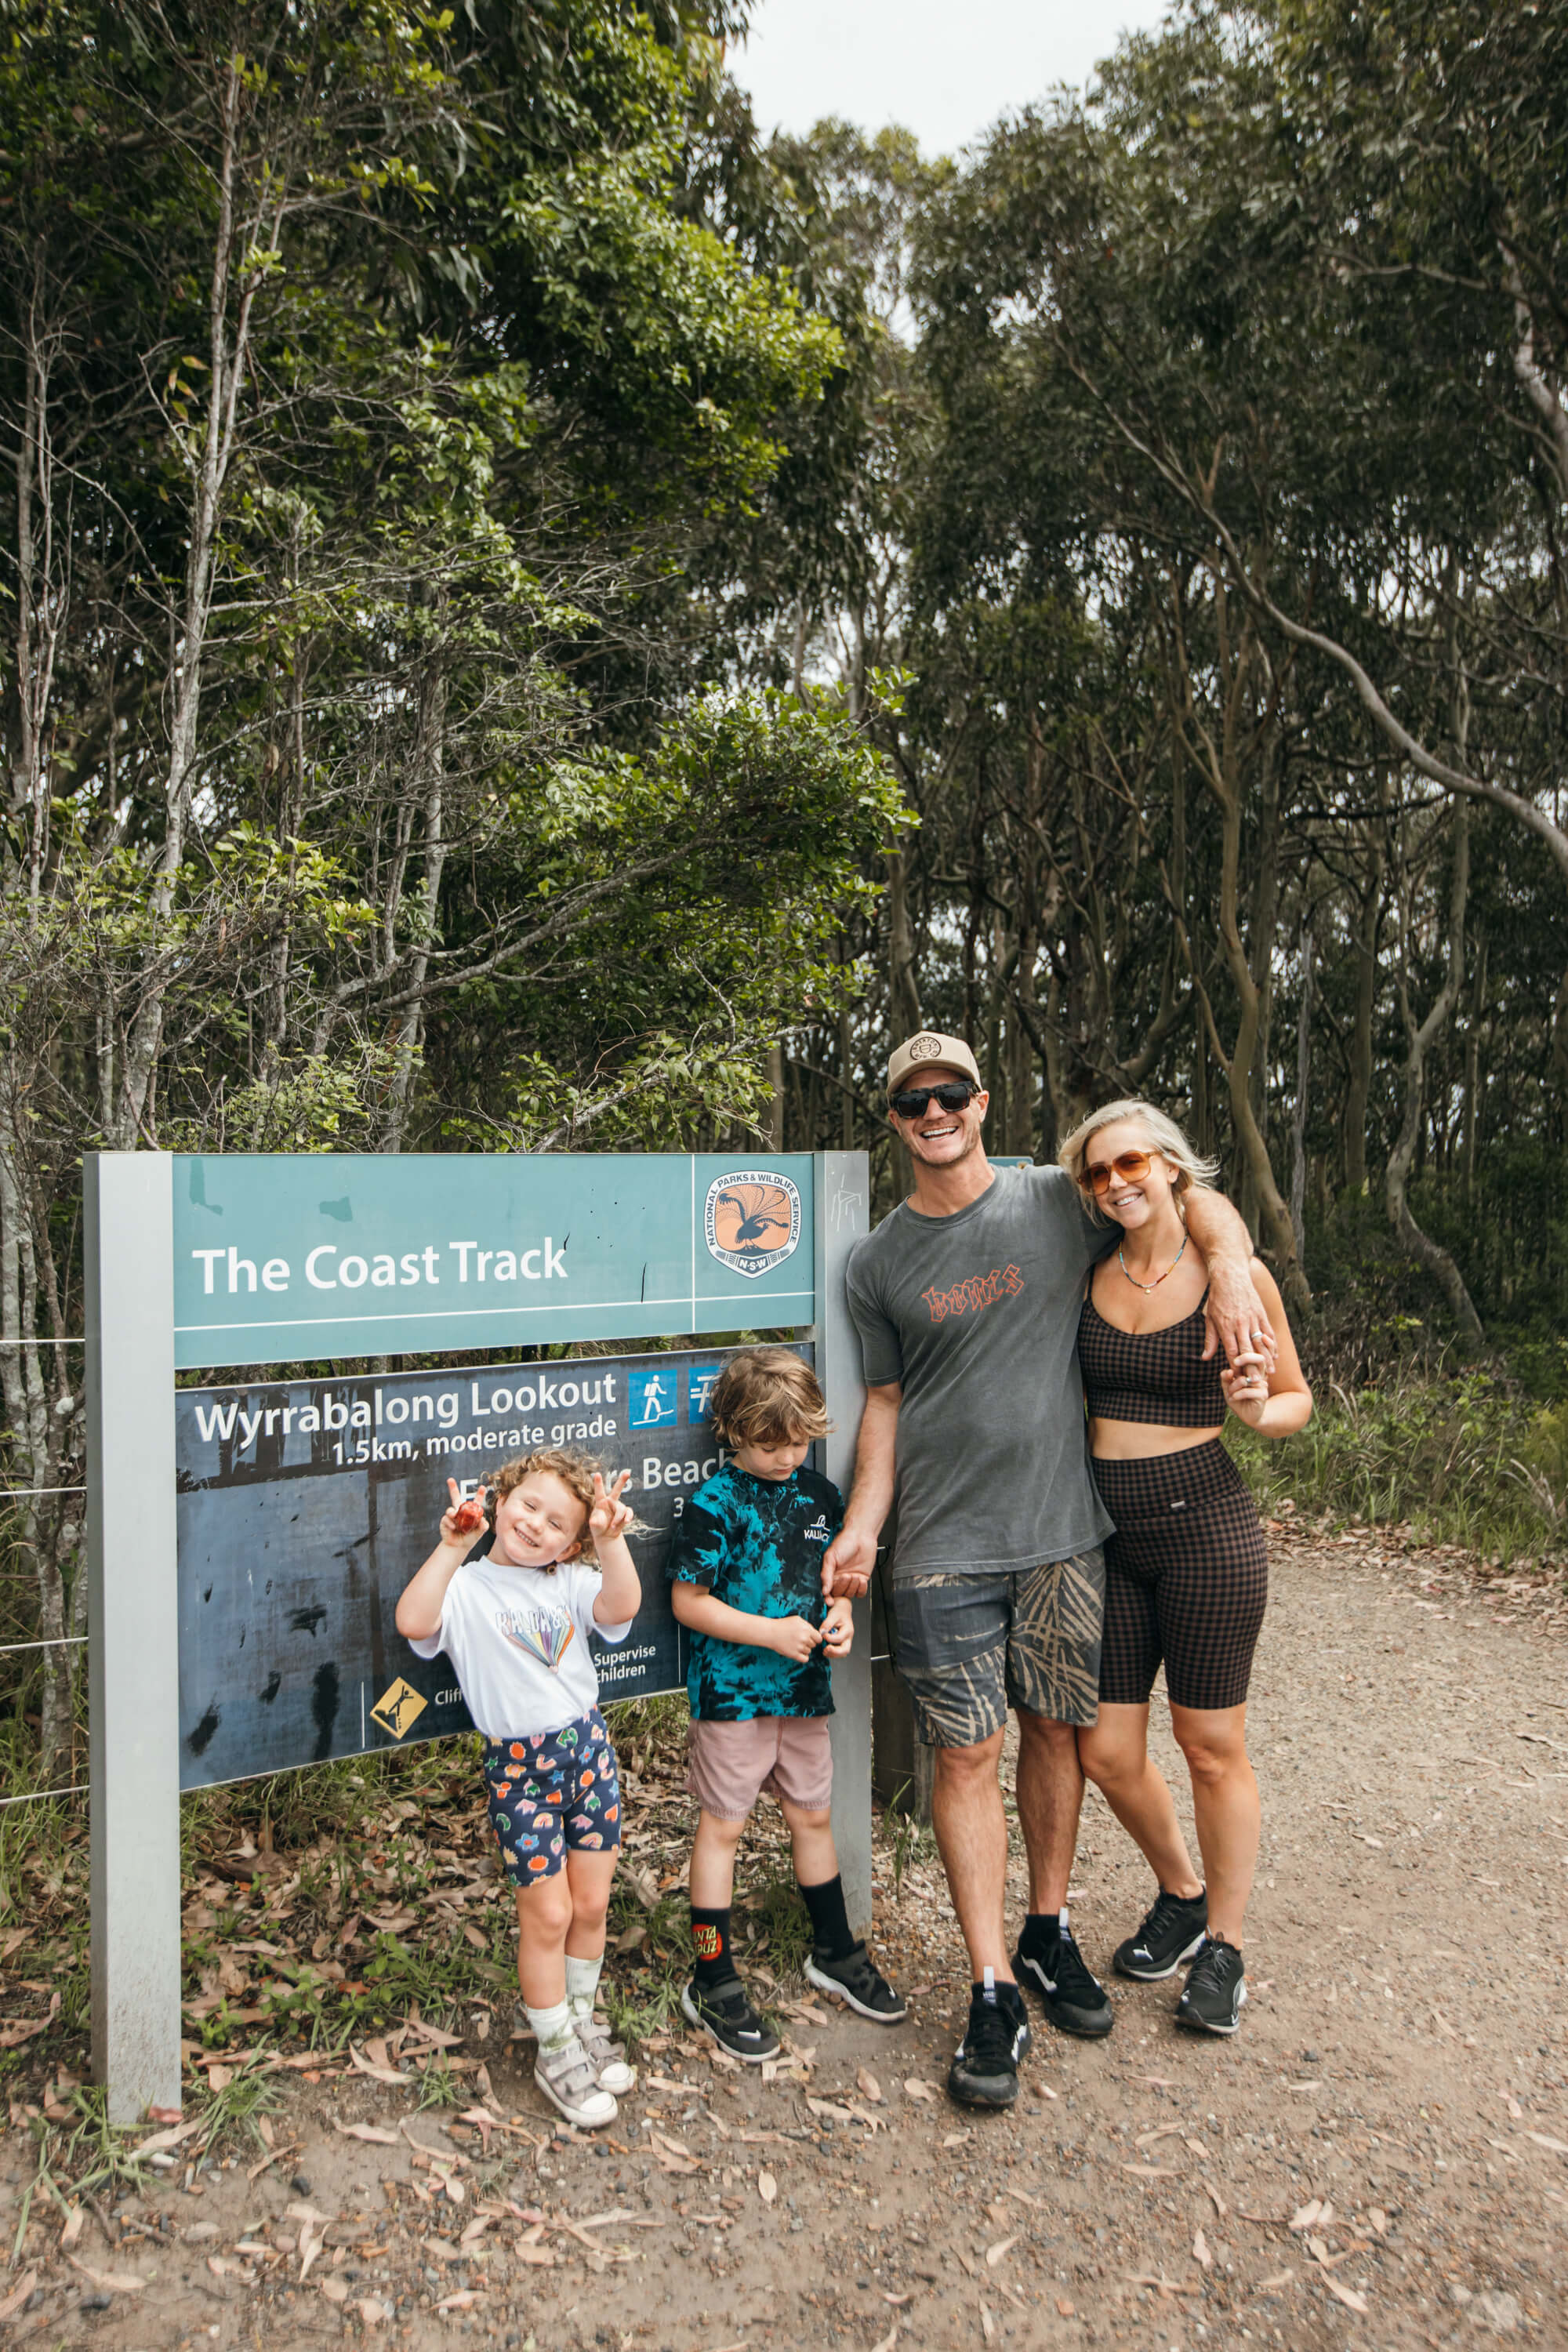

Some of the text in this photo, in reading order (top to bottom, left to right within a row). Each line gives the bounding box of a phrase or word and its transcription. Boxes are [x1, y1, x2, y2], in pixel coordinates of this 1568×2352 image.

[706, 1189, 718, 1246] NATIONAL
[717, 1174, 749, 1187] PARKS
[757, 1174, 796, 1196] WILDLIFE
[789, 1196, 799, 1243] SERVICE
[192, 1236, 568, 1294] The Coast Track
[194, 1374, 616, 1450] Wyrrabalong Lookout
[332, 1414, 617, 1467] 1.5km, moderate grade
[594, 1645, 656, 1668] Supervise
[596, 1664, 646, 1683] children
